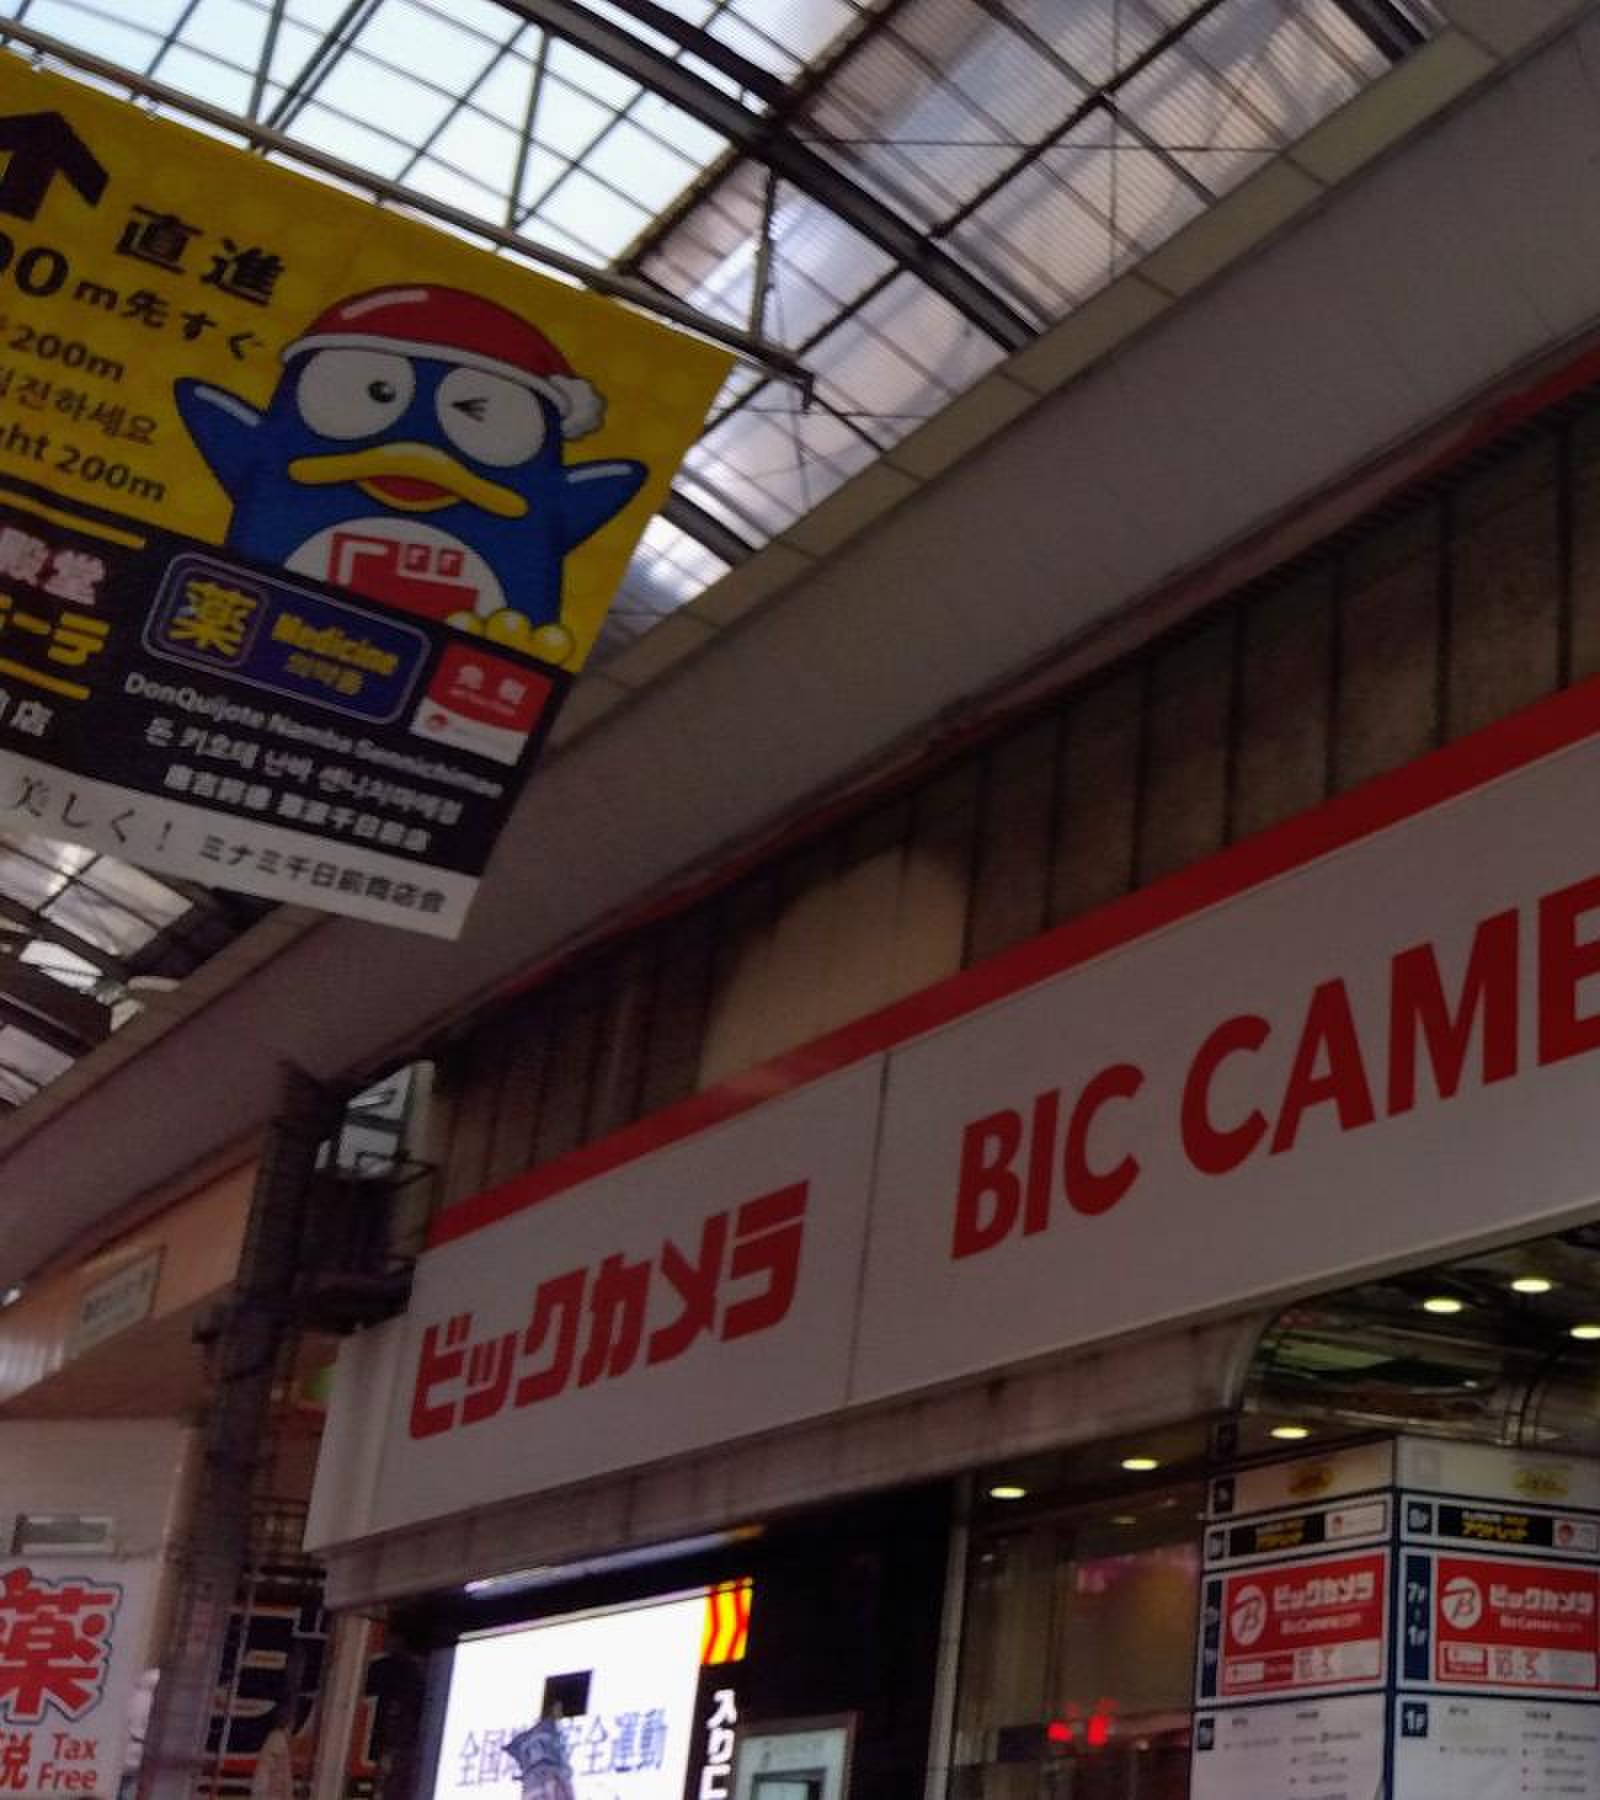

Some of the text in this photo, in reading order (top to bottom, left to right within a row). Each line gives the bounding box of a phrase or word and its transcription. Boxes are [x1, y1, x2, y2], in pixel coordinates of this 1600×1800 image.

[115, 204, 285, 307] 直進
[9, 324, 125, 385] 200m
[55, 444, 166, 502] 200m
[0, 592, 112, 667] ーテ
[950, 1062, 1147, 1260] BIC
[409, 1180, 809, 1440] ビックカメラ
[37, 1762, 97, 1791] Free
[52, 1733, 97, 1761] Tax
